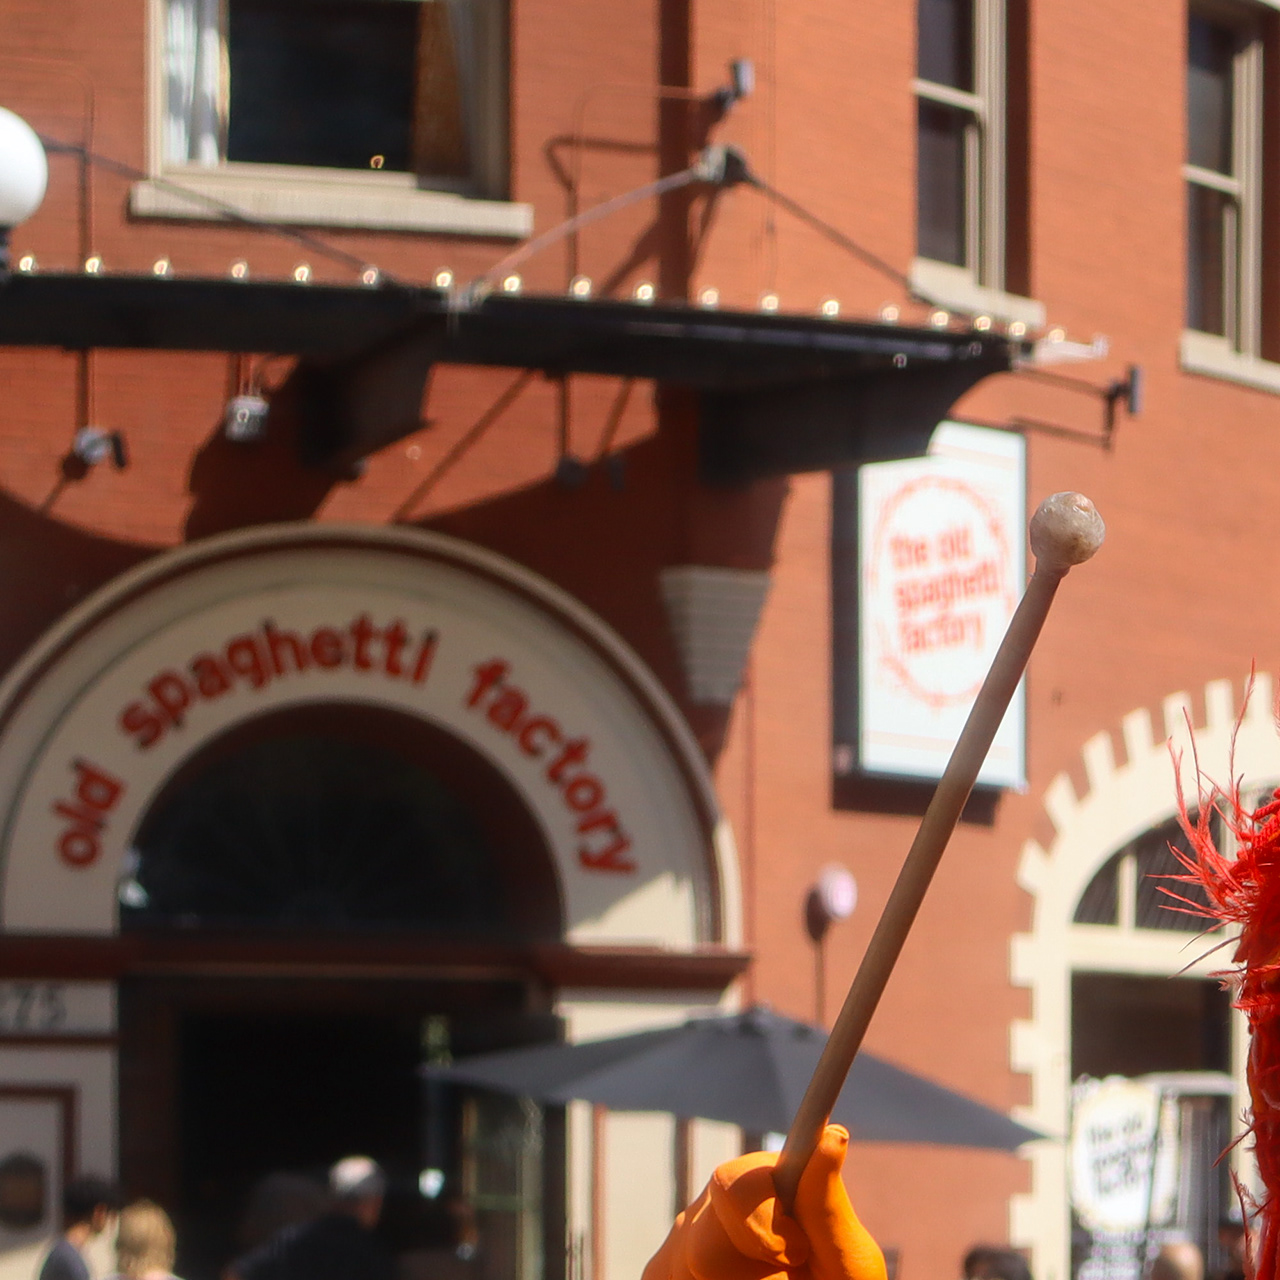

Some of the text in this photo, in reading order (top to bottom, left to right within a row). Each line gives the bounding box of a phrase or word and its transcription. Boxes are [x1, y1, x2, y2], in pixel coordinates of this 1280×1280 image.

[54, 612, 638, 877] old spaghetti factory
